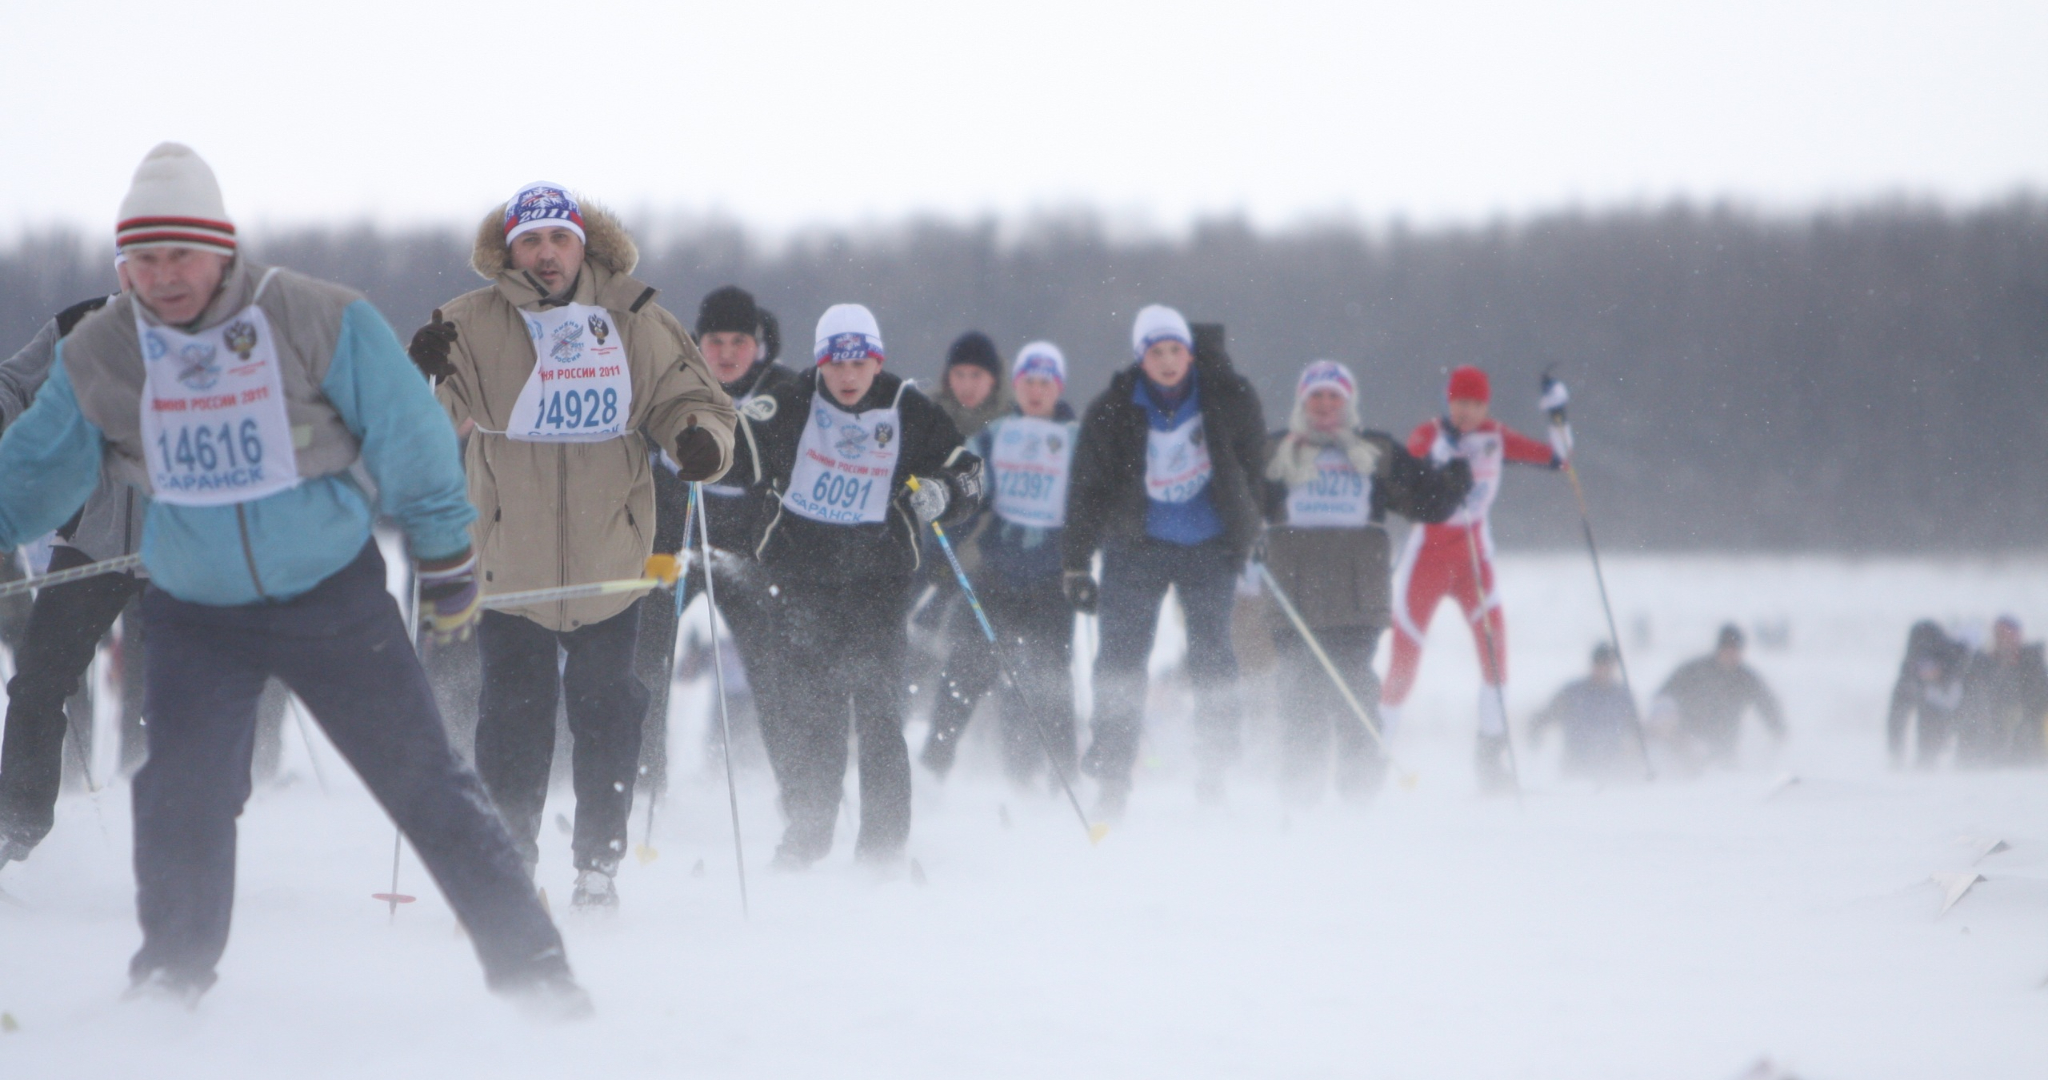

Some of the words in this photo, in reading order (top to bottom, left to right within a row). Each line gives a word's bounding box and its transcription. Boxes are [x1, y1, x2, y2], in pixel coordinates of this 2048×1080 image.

[518, 207, 570, 224] 2011
[832, 351, 866, 359] 2011
[557, 368, 596, 379] РОССИИ
[599, 365, 620, 378] 2011
[191, 394, 237, 411] РОССИИ
[240, 386, 269, 405] 2011
[534, 387, 618, 430] 14928
[157, 418, 263, 473] 14616
[812, 471, 873, 510] 6091
[791, 492, 864, 521] САРАНСК
